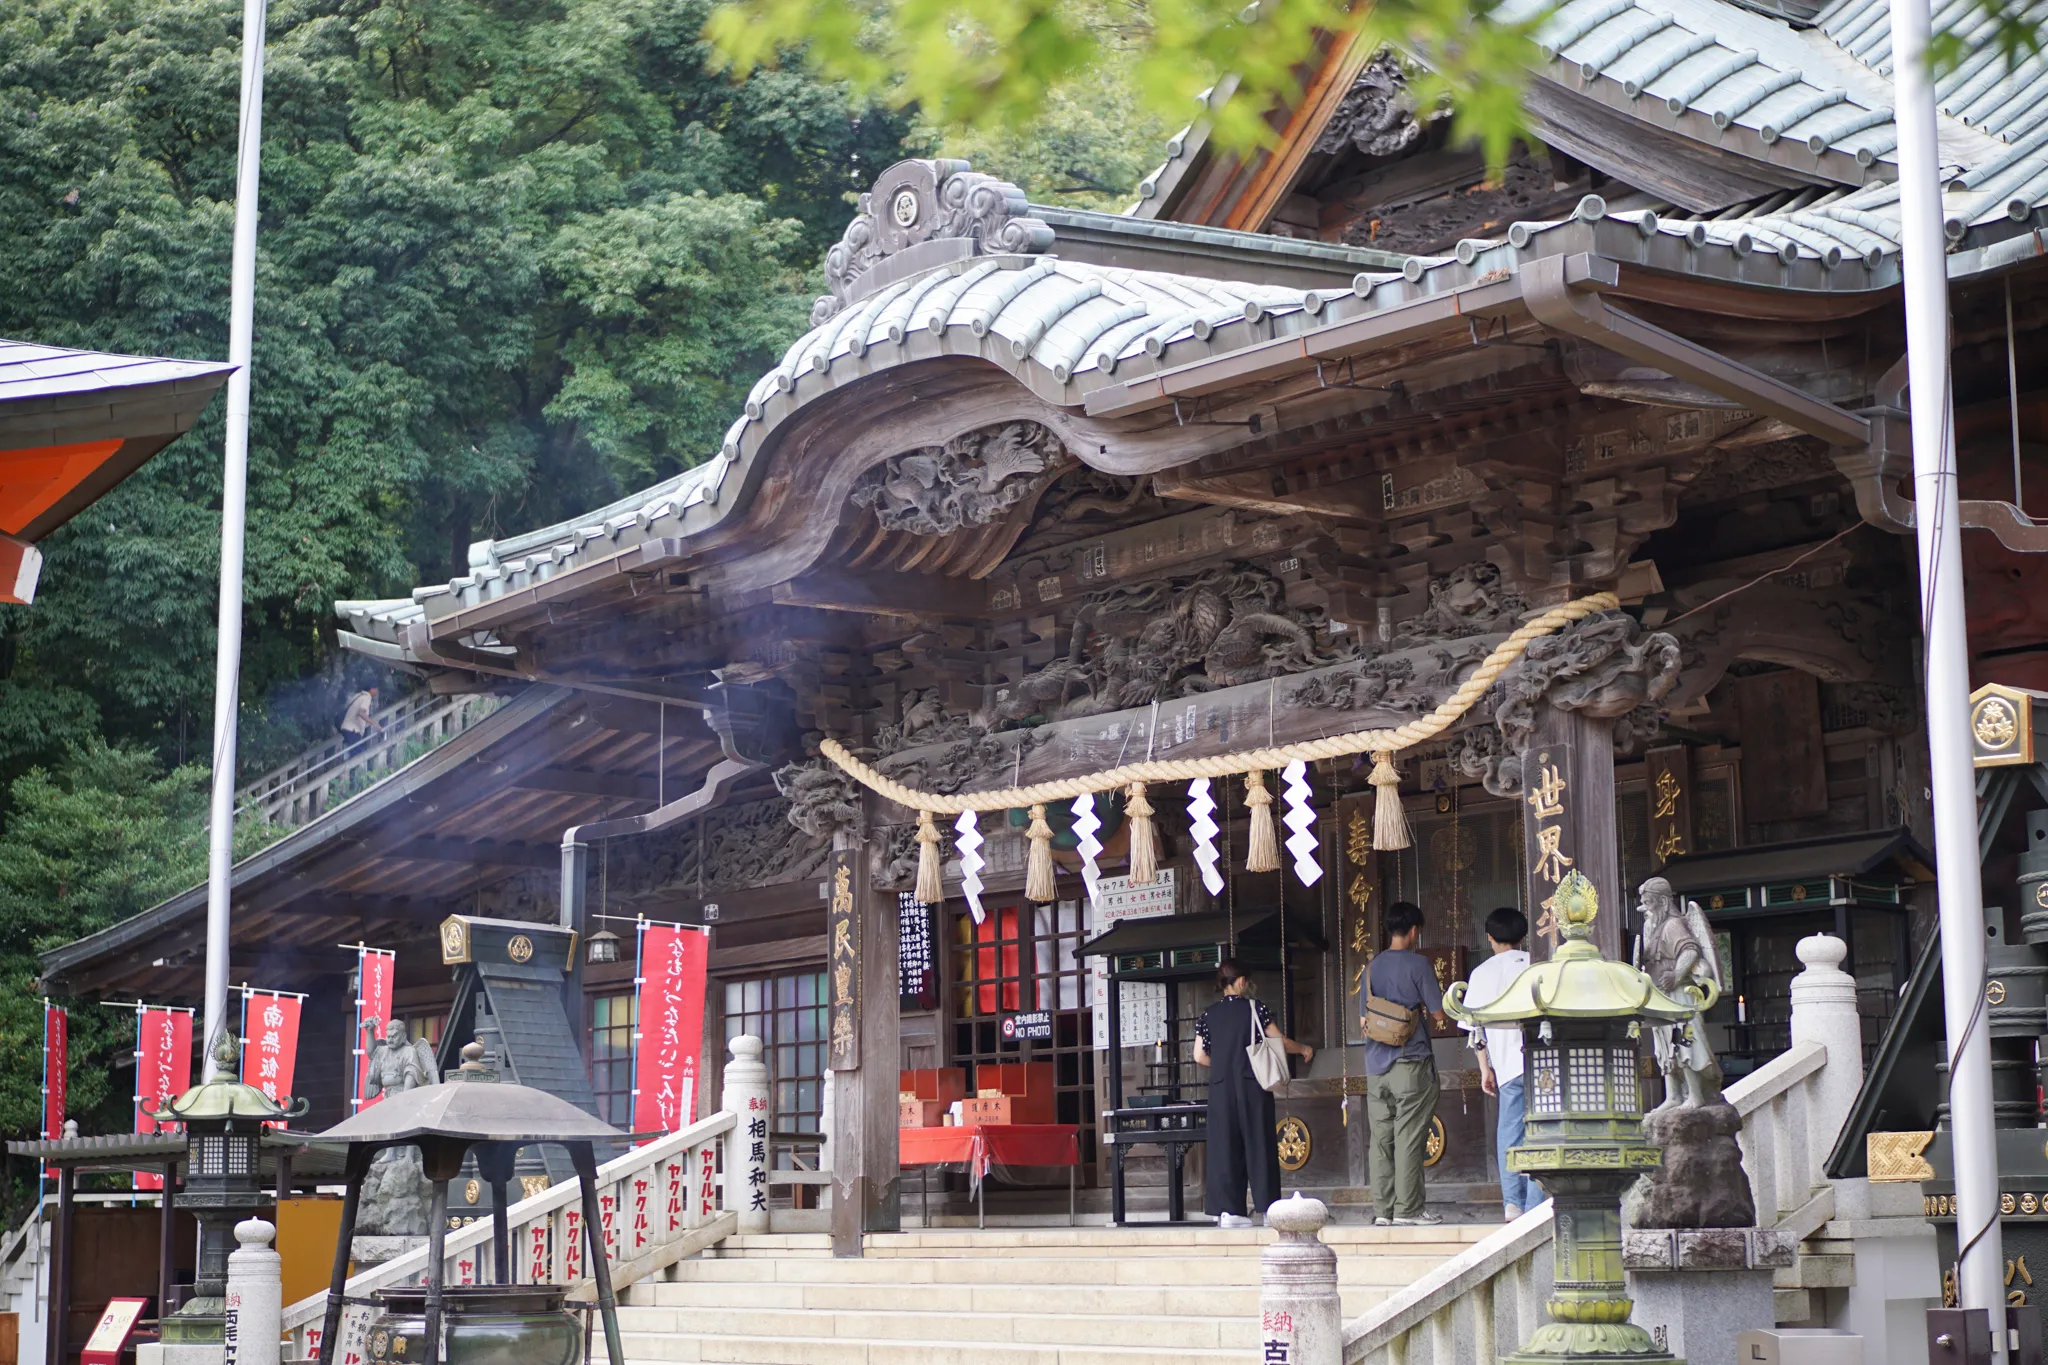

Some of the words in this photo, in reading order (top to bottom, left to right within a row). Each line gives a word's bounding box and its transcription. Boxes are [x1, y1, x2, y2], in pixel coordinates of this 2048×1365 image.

[1014, 1012, 1050, 1025] 堂内撮影禁止
[1015, 1027, 1025, 1038] NO
[1027, 1025, 1051, 1036] PHOTO
[748, 1097, 768, 1112] 奉納
[667, 1163, 681, 1232] ヤクルト
[700, 1148, 714, 1216] ヤクルト
[747, 1116, 768, 1212] 相馬和夫
[566, 1210, 580, 1280] ヤクルト
[634, 1179, 648, 1248] ヤクルト
